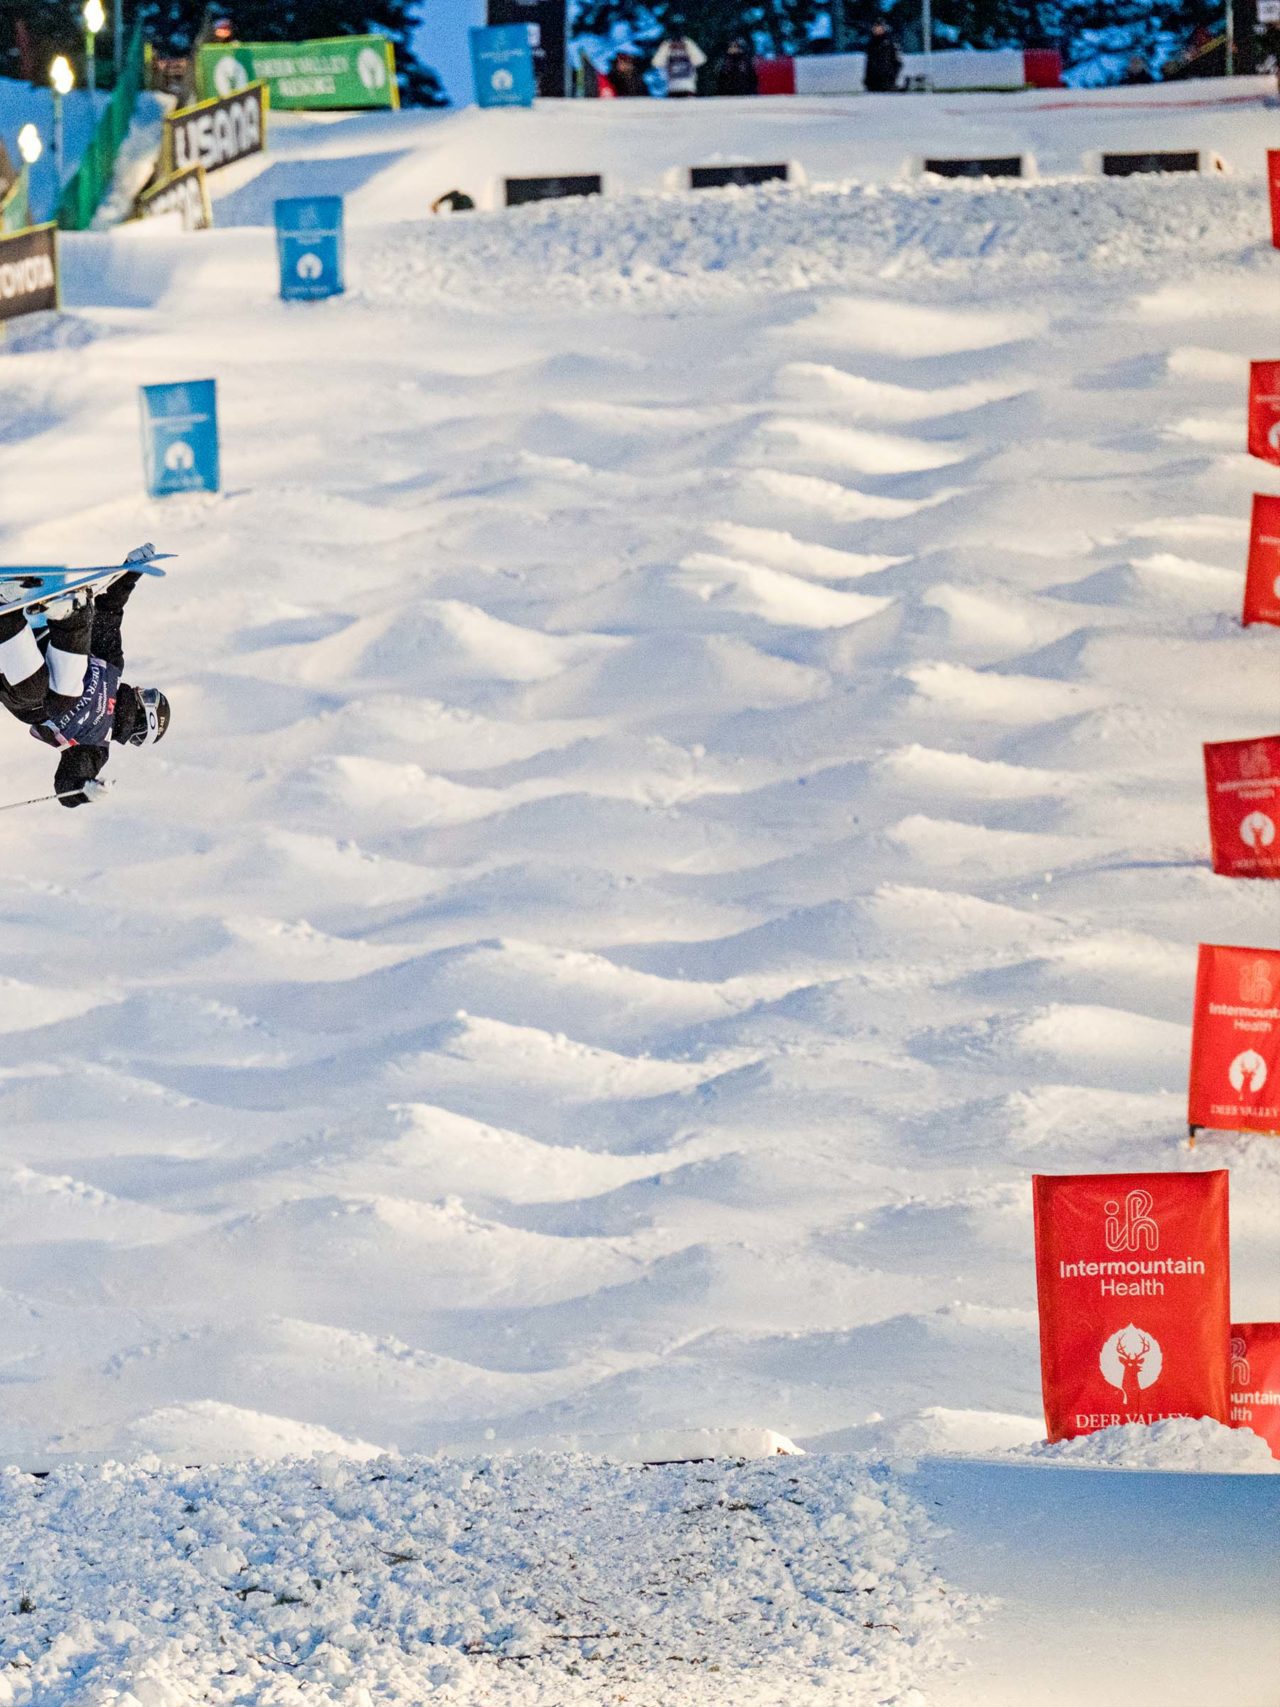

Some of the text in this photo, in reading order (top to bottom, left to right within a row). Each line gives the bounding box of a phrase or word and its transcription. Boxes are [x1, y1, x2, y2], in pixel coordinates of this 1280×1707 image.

[174, 96, 259, 169] USANA
[1209, 1002, 1280, 1019] Intermount
[1233, 1019, 1272, 1032] Health
[1059, 1256, 1206, 1279] Intermountain
[1100, 1278, 1165, 1297] Health
[1230, 1390, 1280, 1405] untain
[1075, 1413, 1122, 1429] DEER
